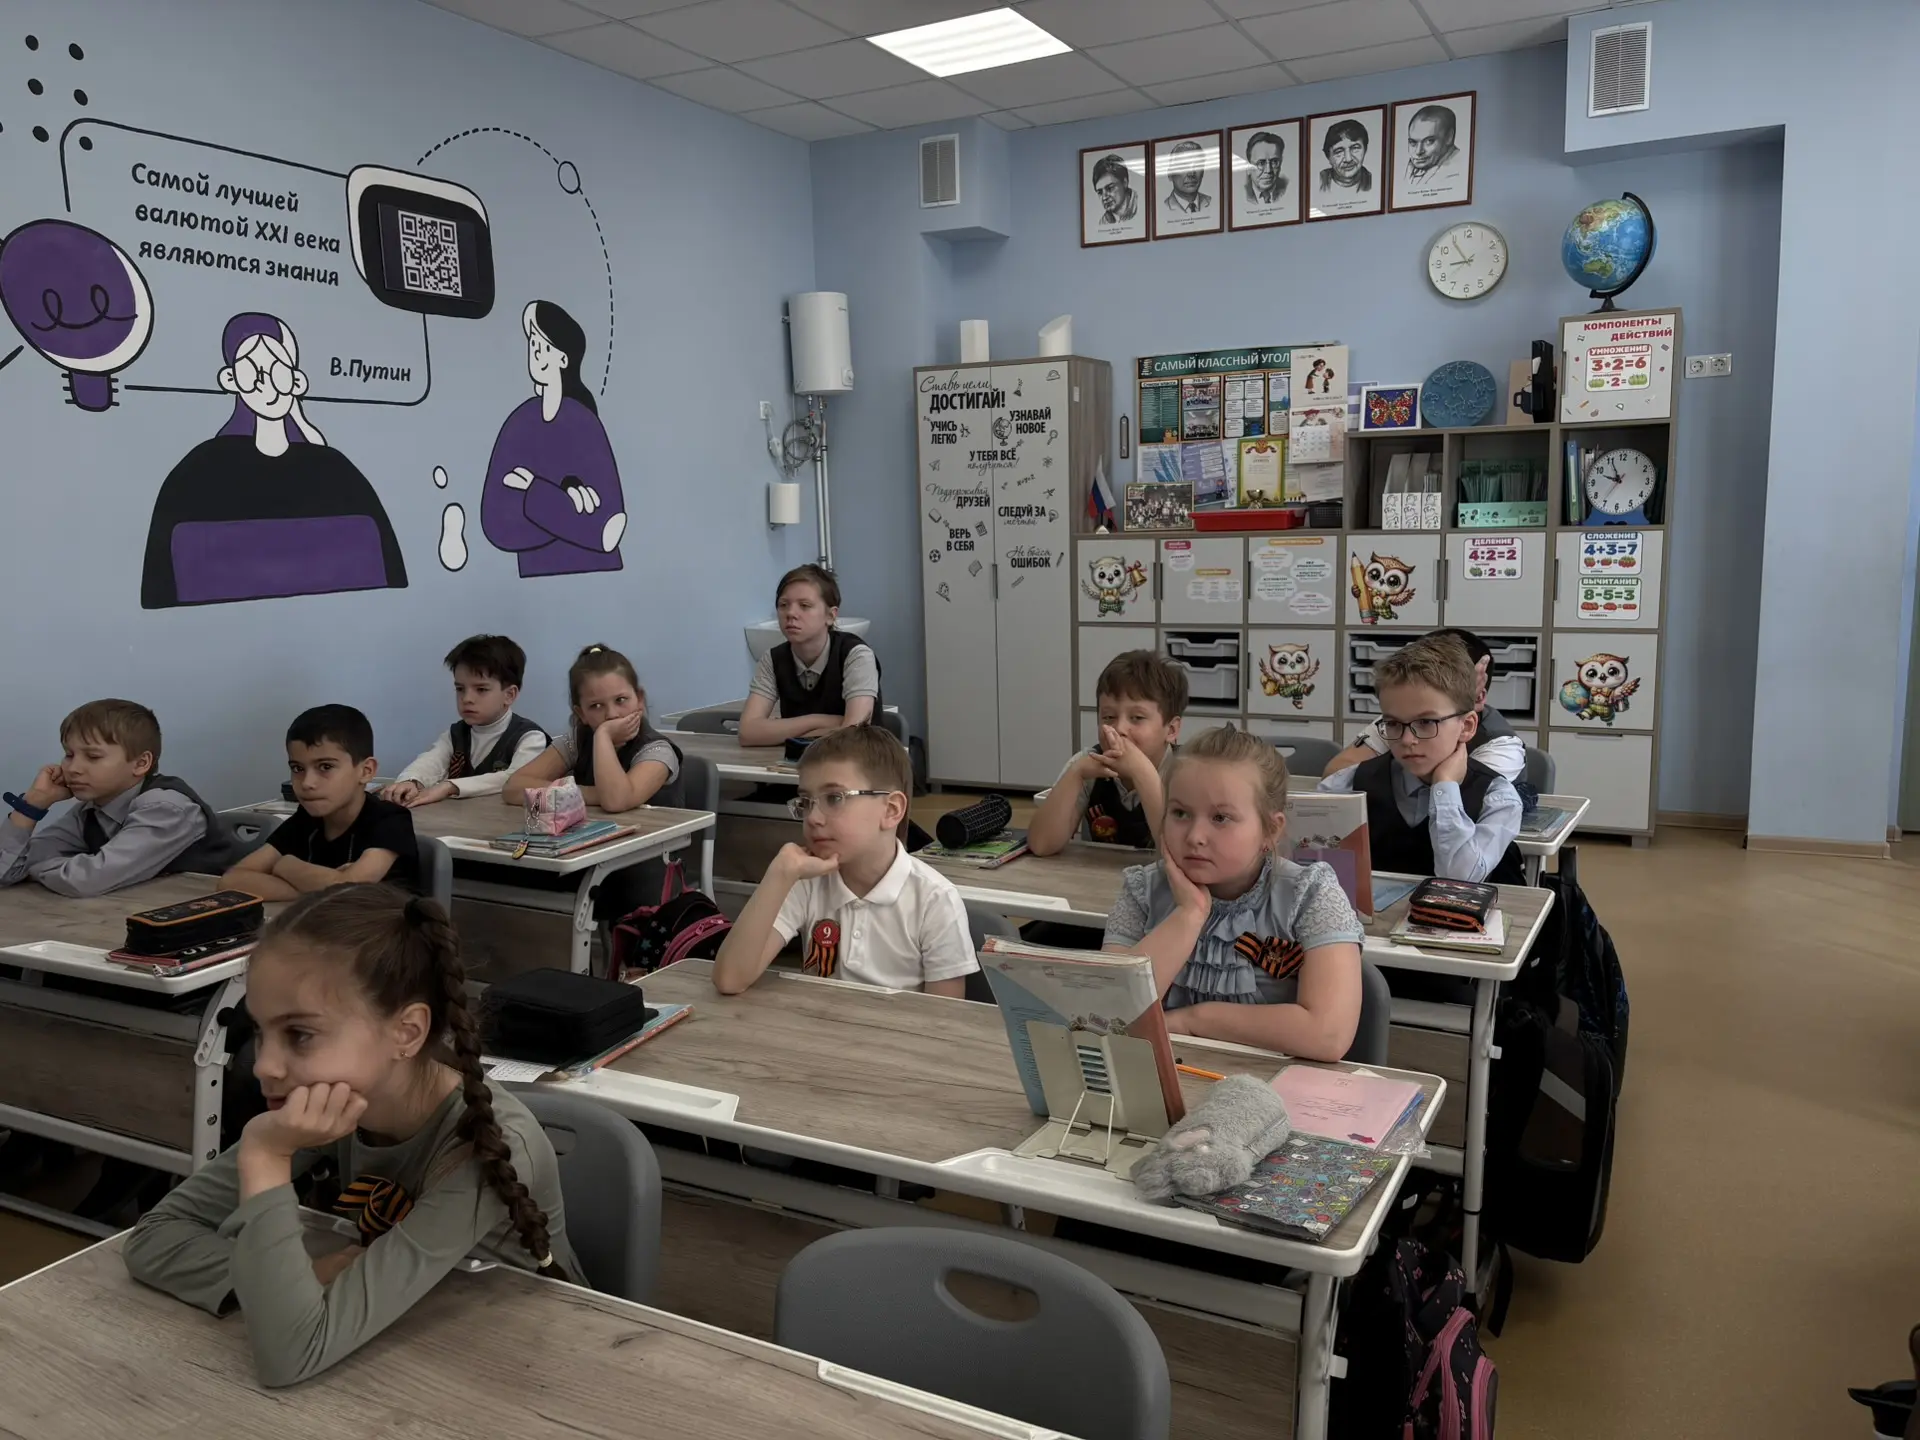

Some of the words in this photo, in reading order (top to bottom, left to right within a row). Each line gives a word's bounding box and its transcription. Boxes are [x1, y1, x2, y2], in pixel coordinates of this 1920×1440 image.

[131, 162, 210, 197] Самой
[215, 183, 299, 213] лучшей
[134, 203, 249, 238] валютой
[255, 220, 289, 244] XXI
[294, 231, 341, 254] века
[1464, 229, 1472, 239] 12
[1488, 240, 1496, 250] 2
[1440, 246, 1449, 256] 10
[138, 240, 261, 275] являются
[265, 259, 339, 287] знания
[1436, 259, 1442, 269] 9
[1493, 254, 1499, 264] 3
[1440, 272, 1446, 282] 8
[1487, 268, 1495, 277] 4
[1450, 281, 1456, 291] 7
[1463, 284, 1470, 293] 6
[1477, 279, 1484, 289] 5
[1583, 317, 1662, 331] КОМПОНЕНТЫ
[1610, 327, 1673, 342] ДЕЙСТВИЙ
[1591, 345, 1648, 355] УМНОЖЕНИЕ
[1154, 357, 1196, 372] САМЫЙ
[1198, 352, 1259, 368] КЛАССНЫЙ
[1261, 352, 1290, 364] УГОЛ
[329, 356, 411, 384] В.Путин
[919, 370, 961, 393] Ставь
[929, 387, 1006, 415] ДОСТИГАЙ!
[1009, 406, 1052, 422] УЗНАВАЙ
[930, 420, 958, 432] УЧИСЬ
[1016, 421, 1046, 434] НОВОЕ
[930, 433, 957, 445] ЛЕГКО
[969, 450, 975, 461] У
[976, 450, 998, 461] ТЕБЯ
[1619, 453, 1628, 462] 12
[1596, 466, 1604, 475] 10
[1642, 464, 1648, 473] 2
[1590, 478, 1596, 487] 9
[1644, 477, 1650, 486] 3
[1593, 491, 1599, 500] 8
[1638, 490, 1644, 498] 4
[955, 494, 991, 510] ДРУЗЕЙ
[1602, 500, 1607, 508] 7
[1614, 503, 1619, 511] 6
[1628, 499, 1633, 507] 5
[997, 504, 1033, 519] СЛЕДУЙ
[1034, 506, 1047, 517] ЗА
[949, 528, 972, 539] ВЕРЬ
[1586, 532, 1637, 540] СЛОЖЕНИЕ
[946, 540, 953, 551] В
[953, 540, 975, 551] СЕБЯ
[1474, 538, 1513, 546] ДЕЛЕНИЕ
[1584, 543, 1638, 555] 4+3=7
[1468, 549, 1517, 560] 4:2=2
[1010, 557, 1051, 569] ОШИБОК
[822, 926, 832, 939] 9
